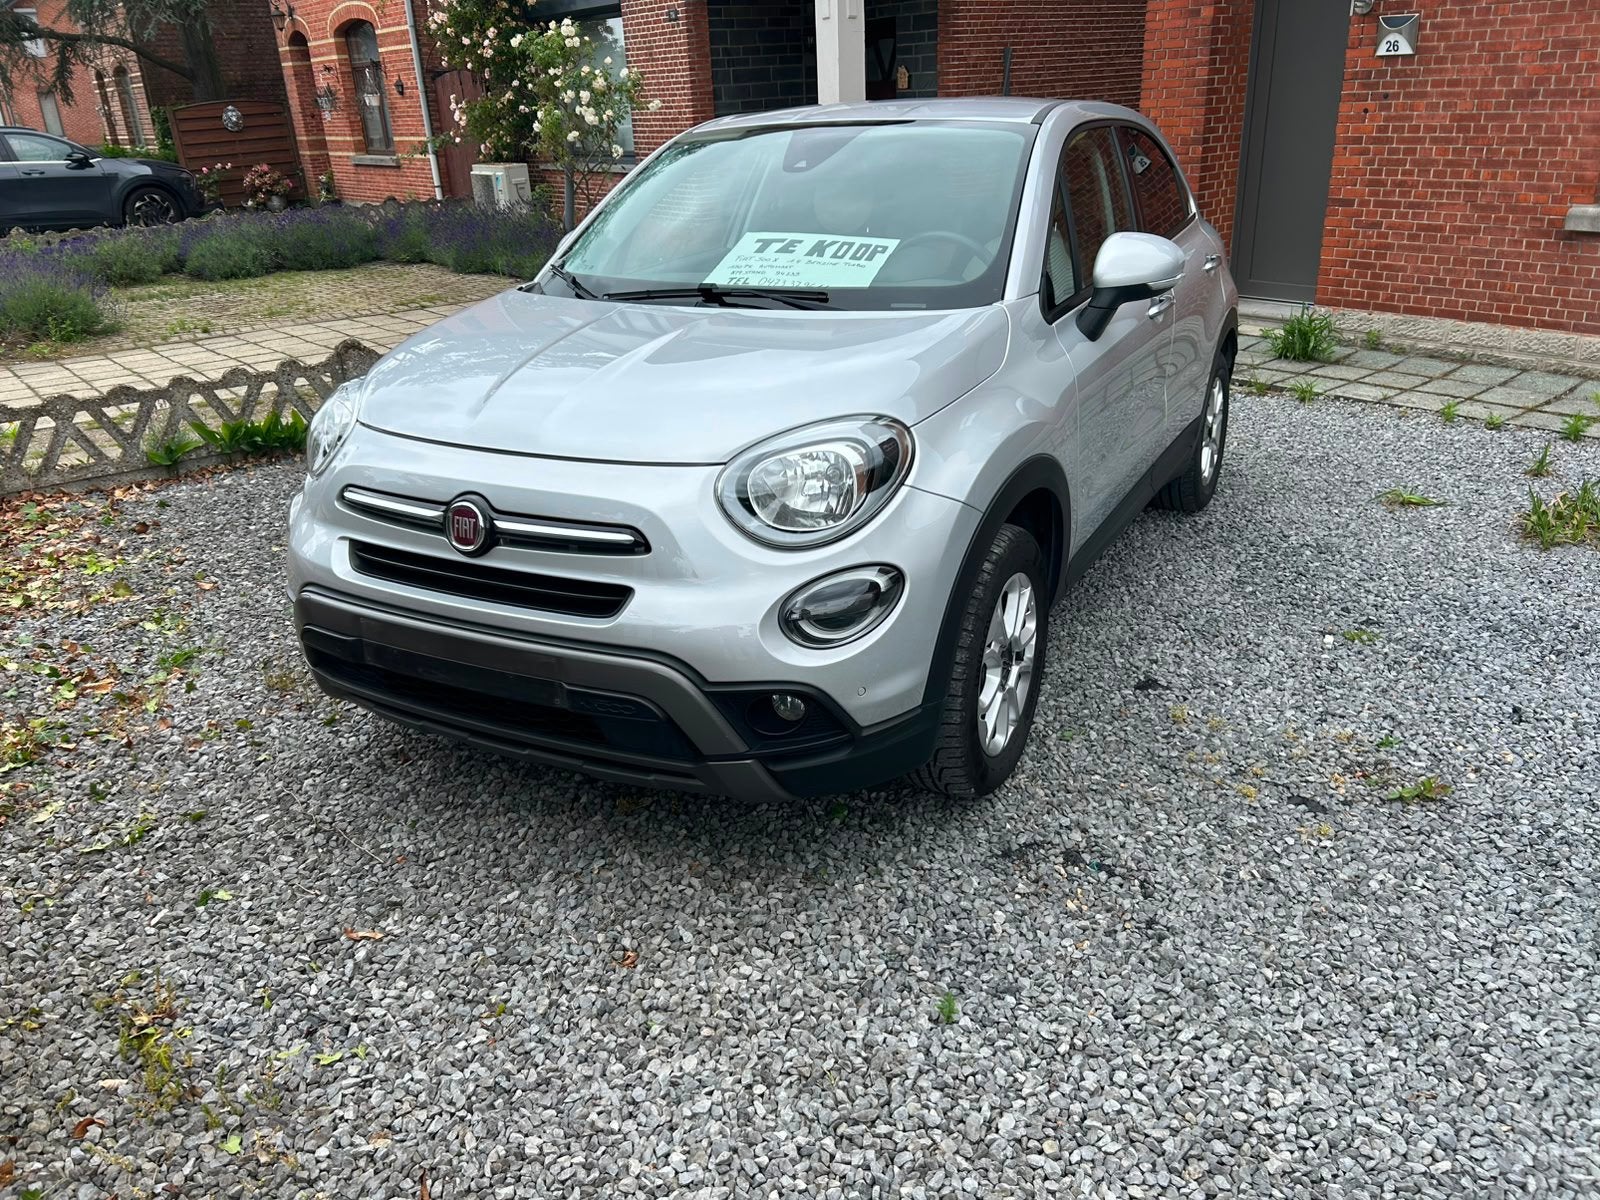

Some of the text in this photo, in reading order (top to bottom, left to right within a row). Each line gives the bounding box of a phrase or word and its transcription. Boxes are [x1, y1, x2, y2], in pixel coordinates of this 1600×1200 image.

[1385, 40, 1399, 52] 26
[753, 238, 889, 262] TE KOOP
[727, 277, 750, 285] TEL
[454, 515, 476, 539] FIAT
